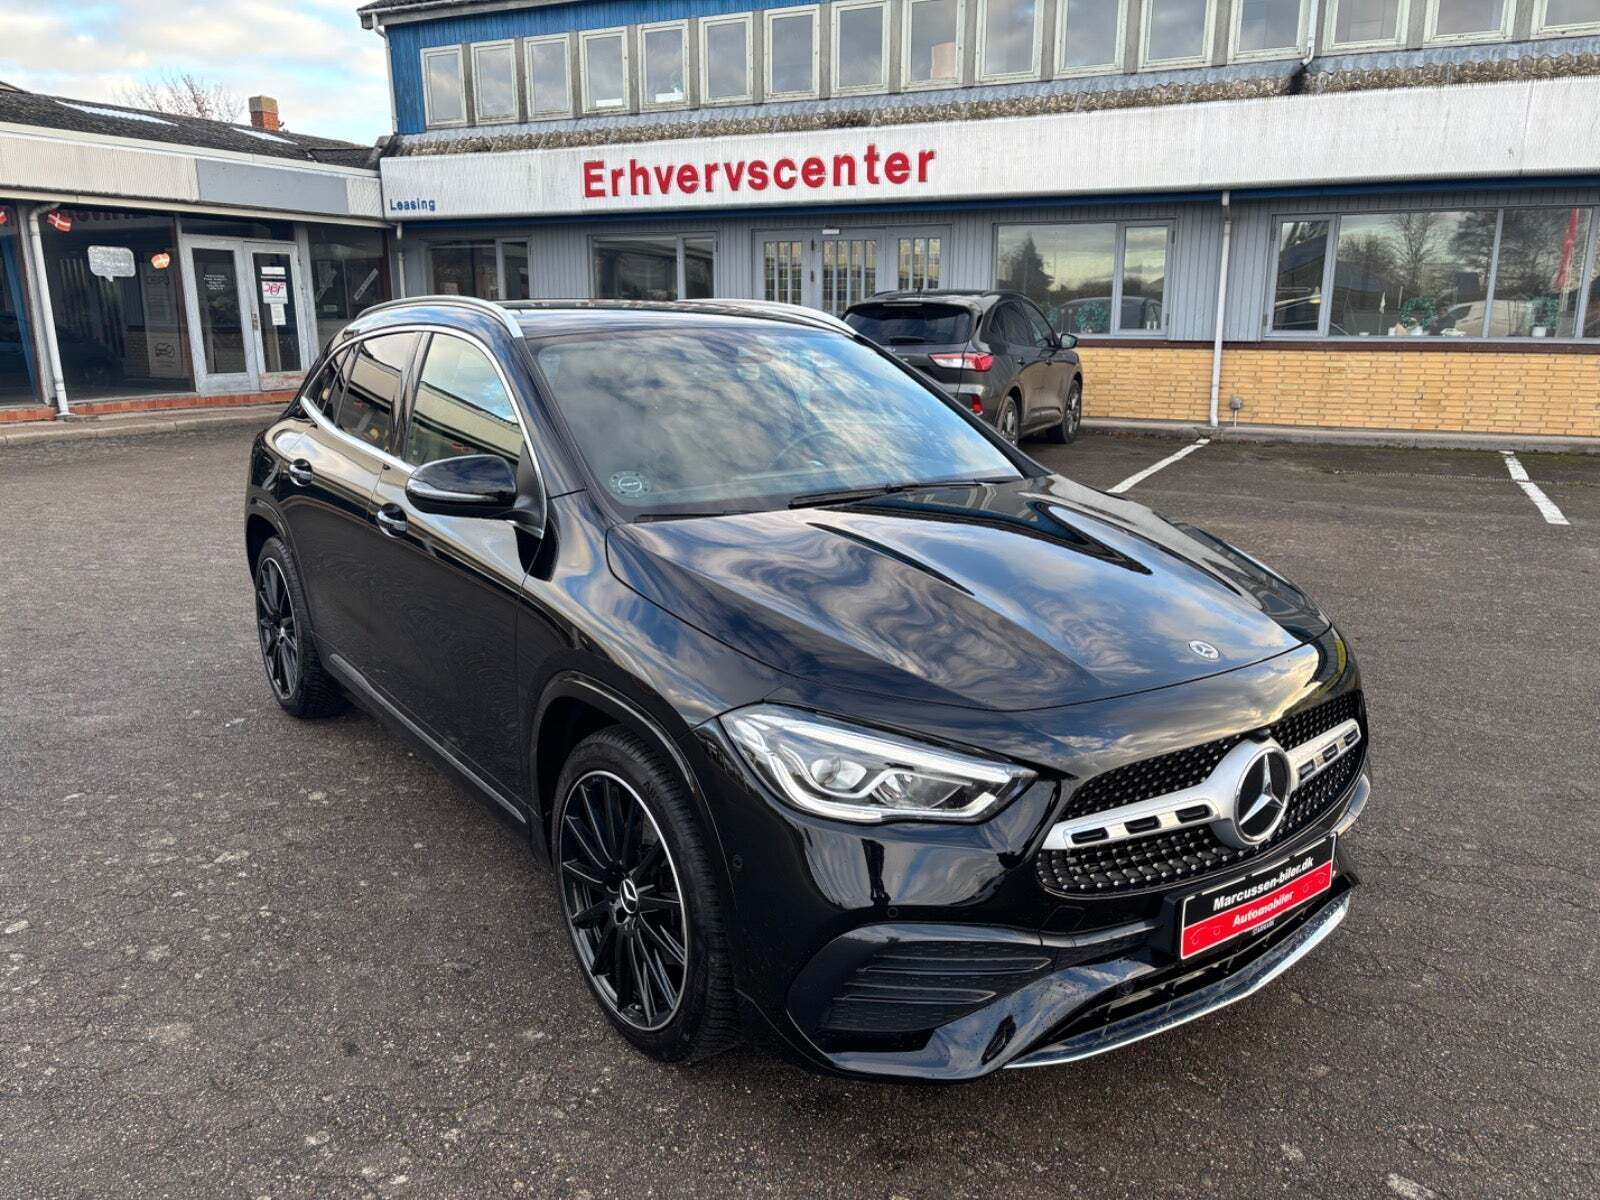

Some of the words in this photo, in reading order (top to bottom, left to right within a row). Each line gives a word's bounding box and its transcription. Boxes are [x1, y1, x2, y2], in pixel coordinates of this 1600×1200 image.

[583, 143, 935, 198] Erhvervscenter
[389, 197, 436, 212] Leasing
[1212, 856, 1314, 912] Marcussen-biler.dk
[1232, 890, 1294, 927] Automobiler
